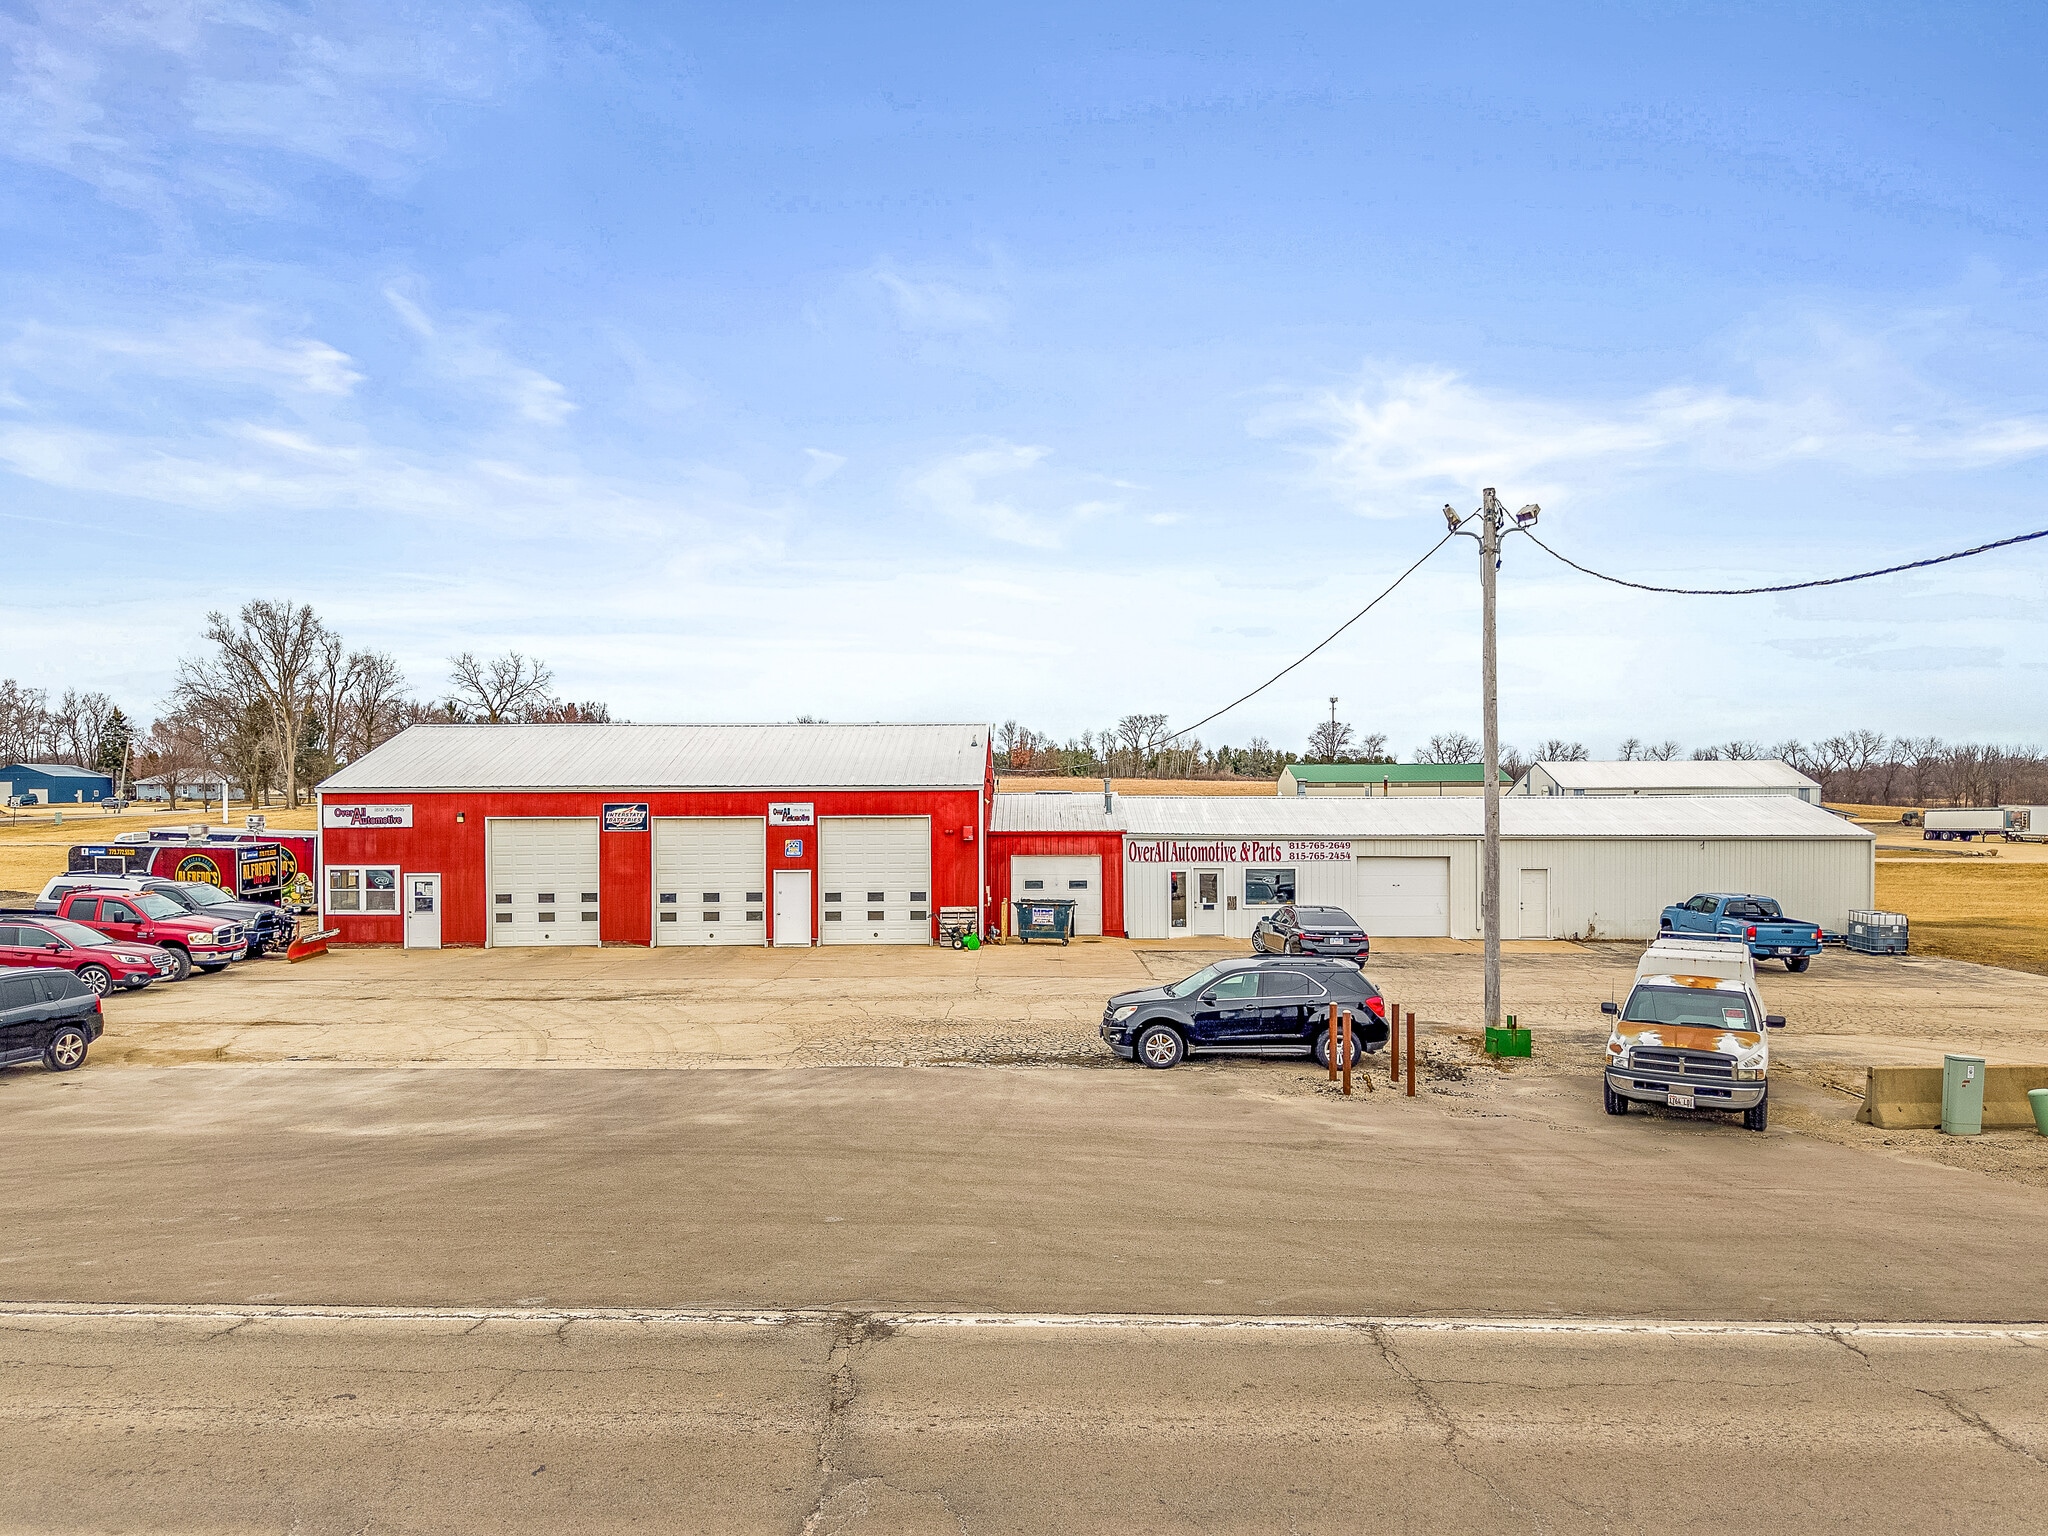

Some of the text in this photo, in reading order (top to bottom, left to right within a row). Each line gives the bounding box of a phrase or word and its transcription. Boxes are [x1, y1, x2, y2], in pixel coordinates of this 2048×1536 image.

[334, 807, 367, 817] OverAll
[350, 814, 402, 825] Automotive
[1289, 841, 1352, 850] 815-765-2649
[1128, 841, 1282, 862] OverAll Automotive & Parts
[1289, 851, 1352, 860] 815-765-2454
[242, 861, 277, 880] ALFREDO'S
